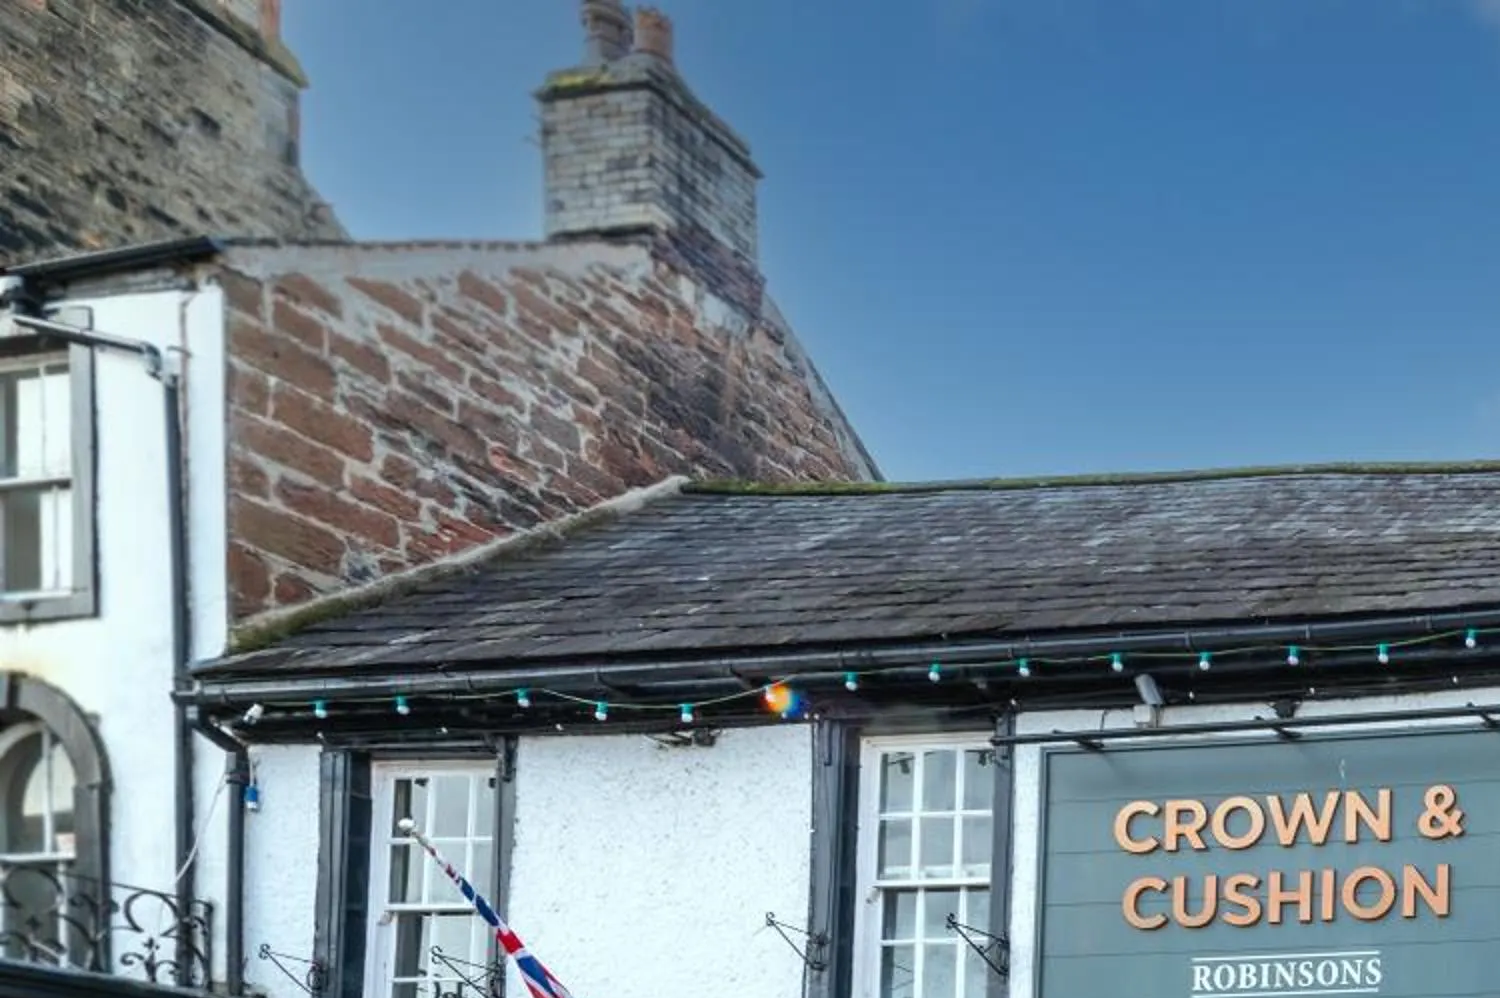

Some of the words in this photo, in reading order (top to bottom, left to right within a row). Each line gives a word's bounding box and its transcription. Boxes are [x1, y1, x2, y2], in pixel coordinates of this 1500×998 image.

[1113, 787, 1392, 855] CROWN
[1416, 783, 1465, 840] &
[1121, 862, 1452, 931] CUSHION
[1192, 957, 1382, 993] ROBINSONS
